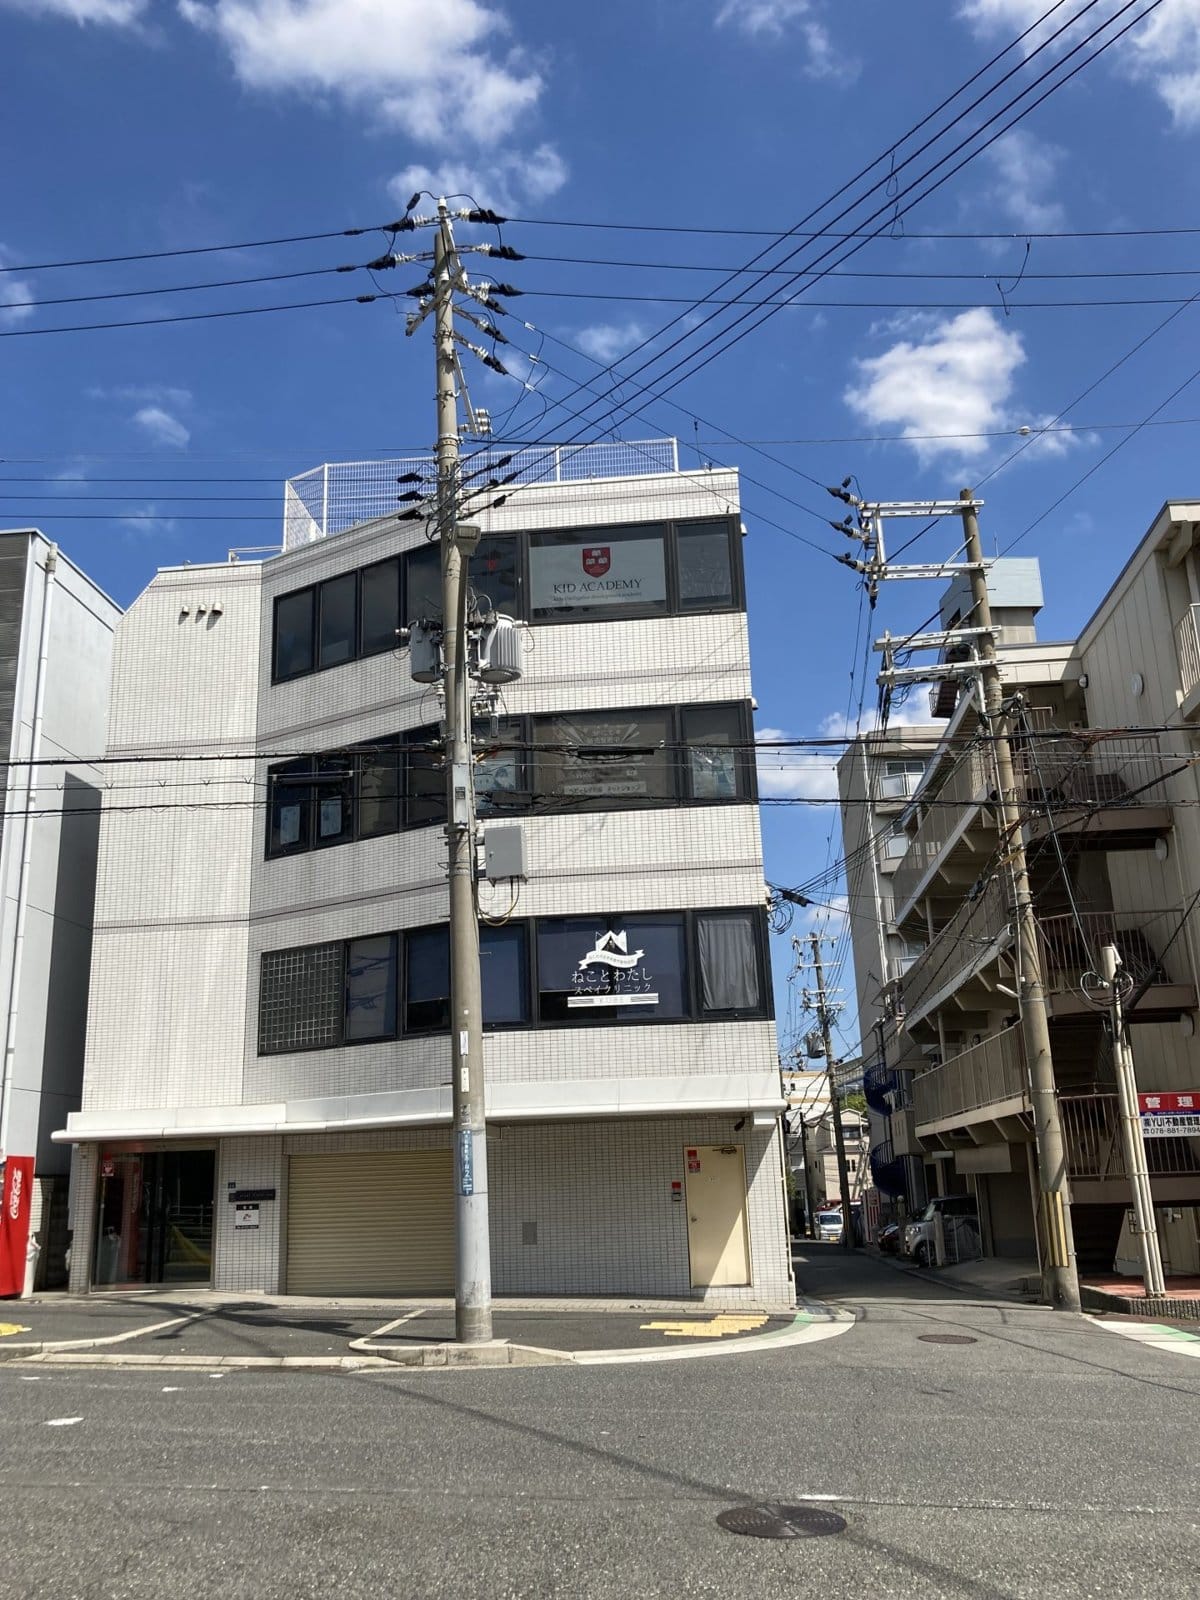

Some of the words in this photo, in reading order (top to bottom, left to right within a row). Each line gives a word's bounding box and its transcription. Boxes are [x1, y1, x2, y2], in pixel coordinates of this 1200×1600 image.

[553, 583, 576, 594] KID
[579, 579, 642, 592] ACADEMY
[571, 968, 653, 984] ねことわたし
[575, 983, 652, 995] スペイクリニック
